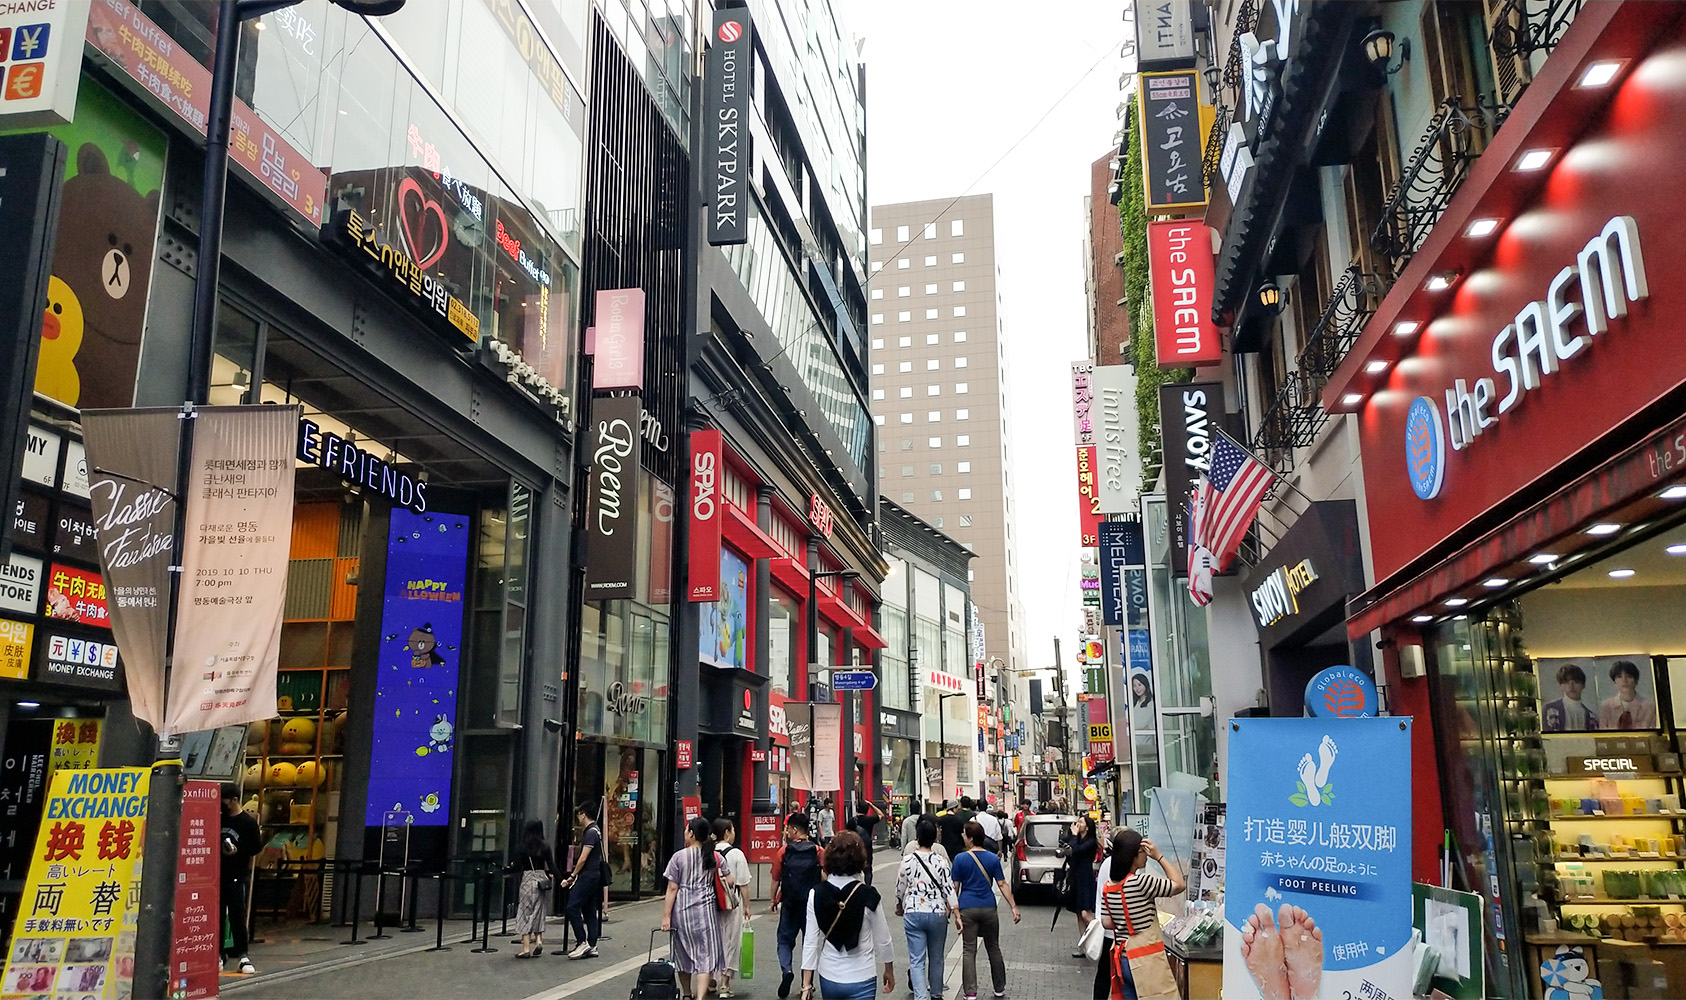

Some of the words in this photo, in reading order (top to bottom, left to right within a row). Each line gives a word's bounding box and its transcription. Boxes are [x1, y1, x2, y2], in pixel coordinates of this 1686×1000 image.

[133, 12, 172, 57] buffet
[722, 49, 735, 103] HOTEL
[137, 63, 205, 129] 牛肉食べ放題
[717, 107, 738, 231] SKYPARK
[496, 219, 520, 261] Beef
[520, 249, 540, 281] Buffet
[1168, 227, 1192, 263] the
[1171, 268, 1201, 355] SAEM
[1446, 378, 1499, 451] the
[1491, 215, 1649, 417] SAEM
[1103, 387, 1128, 491] innisfree
[204, 474, 246, 485] 금난새의
[326, 436, 428, 513] FRIENDS
[594, 418, 634, 537] Roem
[203, 488, 234, 499] 클래식
[237, 487, 278, 499] 판타지아
[694, 452, 715, 521] SPAO
[237, 521, 258, 533] 명동
[1083, 534, 1096, 544] 3F
[196, 568, 218, 577] 2019
[239, 568, 250, 576] 10
[254, 567, 273, 575] THU
[196, 579, 216, 587] 7:00
[407, 579, 447, 592] HAPPY
[48, 662, 75, 674] MONEY
[77, 666, 114, 680] EXCHANGE
[930, 671, 963, 691] ARTBOX
[1317, 670, 1346, 692] global
[1349, 671, 1366, 687] eco
[769, 704, 789, 737] SPA
[1090, 726, 1110, 738] BIG
[1091, 742, 1111, 755] MART
[1583, 758, 1638, 771] SPECIAL
[67, 772, 143, 795] MONEY
[47, 796, 147, 819] EXCHANGE
[1244, 816, 1397, 853] 打造婴儿般双脚
[46, 864, 116, 880] 高いレート
[1260, 850, 1378, 877] 赤ちゃんの足のように
[32, 880, 121, 917] 両替
[1278, 878, 1306, 889] FOOT
[1311, 880, 1357, 896] PEELING
[25, 918, 115, 933] 手数料無いです
[1333, 940, 1369, 961] 使用中
